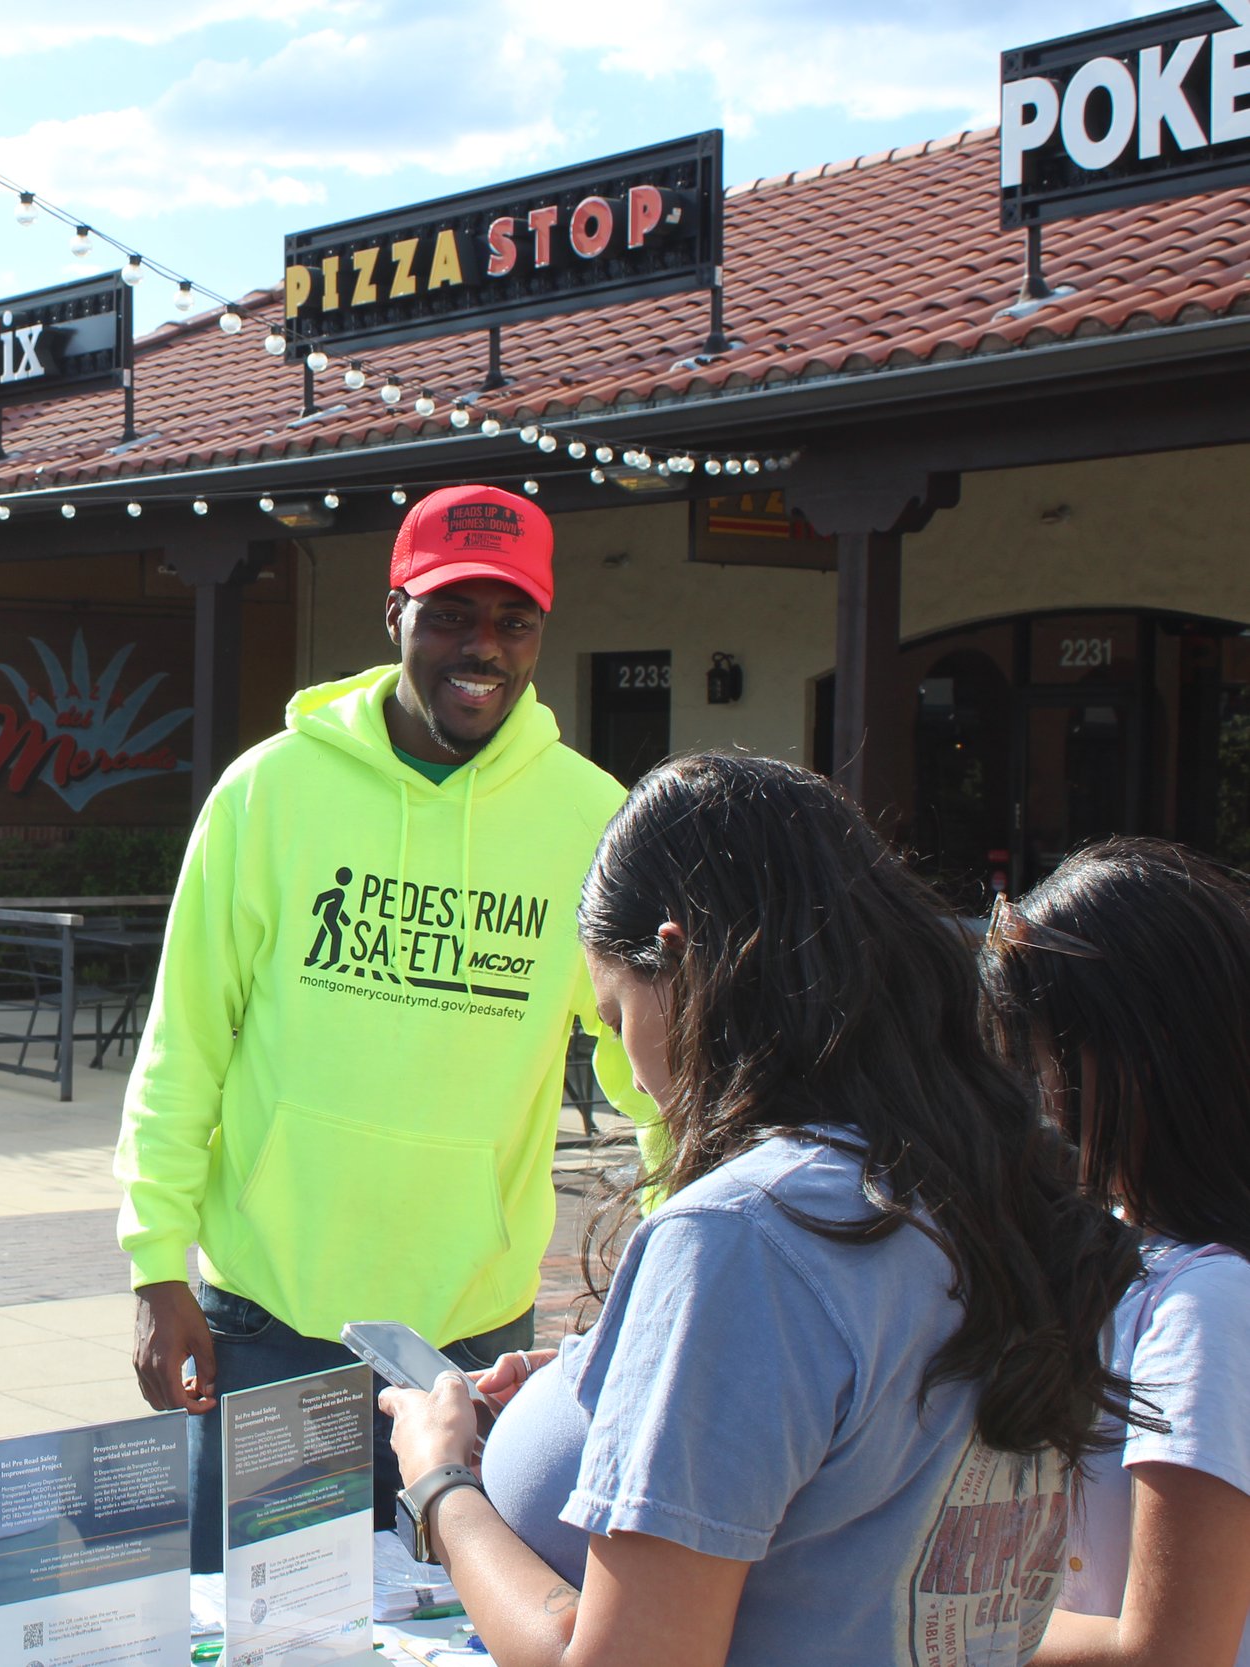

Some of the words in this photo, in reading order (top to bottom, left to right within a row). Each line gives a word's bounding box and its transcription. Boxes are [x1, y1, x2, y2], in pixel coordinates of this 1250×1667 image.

[286, 229, 463, 319] PIZZA
[487, 184, 663, 277] STOP
[453, 506, 482, 519] HEADS
[485, 506, 498, 517] UP
[450, 518, 485, 531] PHONES
[490, 519, 518, 534] DOWN
[1060, 639, 1113, 666] 2231
[618, 665, 671, 688] 2233
[360, 874, 549, 939] PEDESTRIAN
[468, 952, 535, 975] MCDOT
[299, 974, 526, 1021] montgomerycountymd.gov/pedsafety
[94, 1444, 118, 1453] Proyecto
[128, 1440, 147, 1448] mejora
[94, 1452, 120, 1462] seguridad
[1, 1466, 40, 1478] Improvement
[42, 1463, 62, 1471] Project
[24, 1457, 38, 1465] Road
[40, 1455, 57, 1463] Safety
[945, 1607, 956, 1622] EL
[926, 1612, 939, 1654] TABLE
[944, 1623, 957, 1656] MORO
